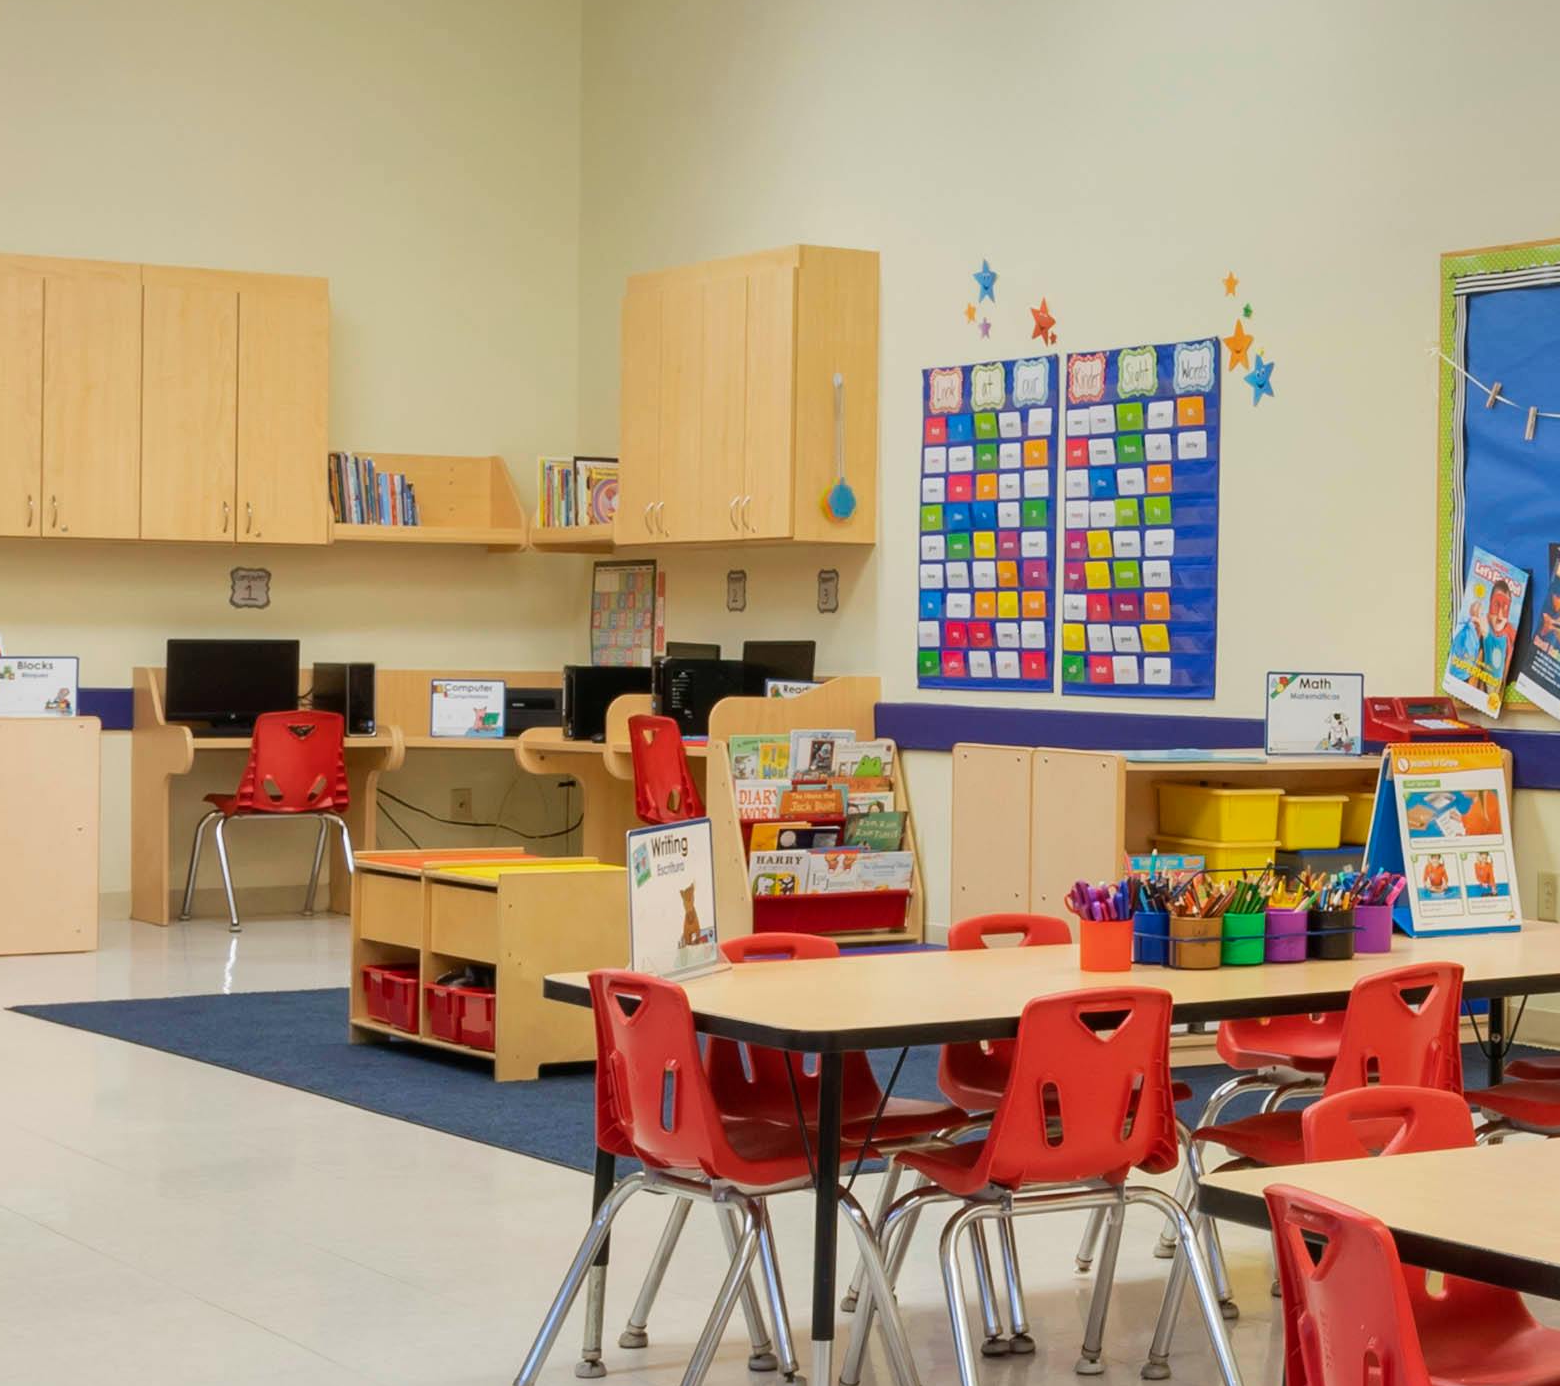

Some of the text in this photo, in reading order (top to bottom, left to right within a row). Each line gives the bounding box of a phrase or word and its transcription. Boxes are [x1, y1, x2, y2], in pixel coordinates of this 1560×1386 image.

[16, 660, 53, 671] Blocks
[445, 682, 493, 694] Computer
[1298, 677, 1331, 690] Math
[651, 836, 688, 858] Writing
[756, 855, 802, 866] HARRY
[656, 861, 685, 877] Escritura
